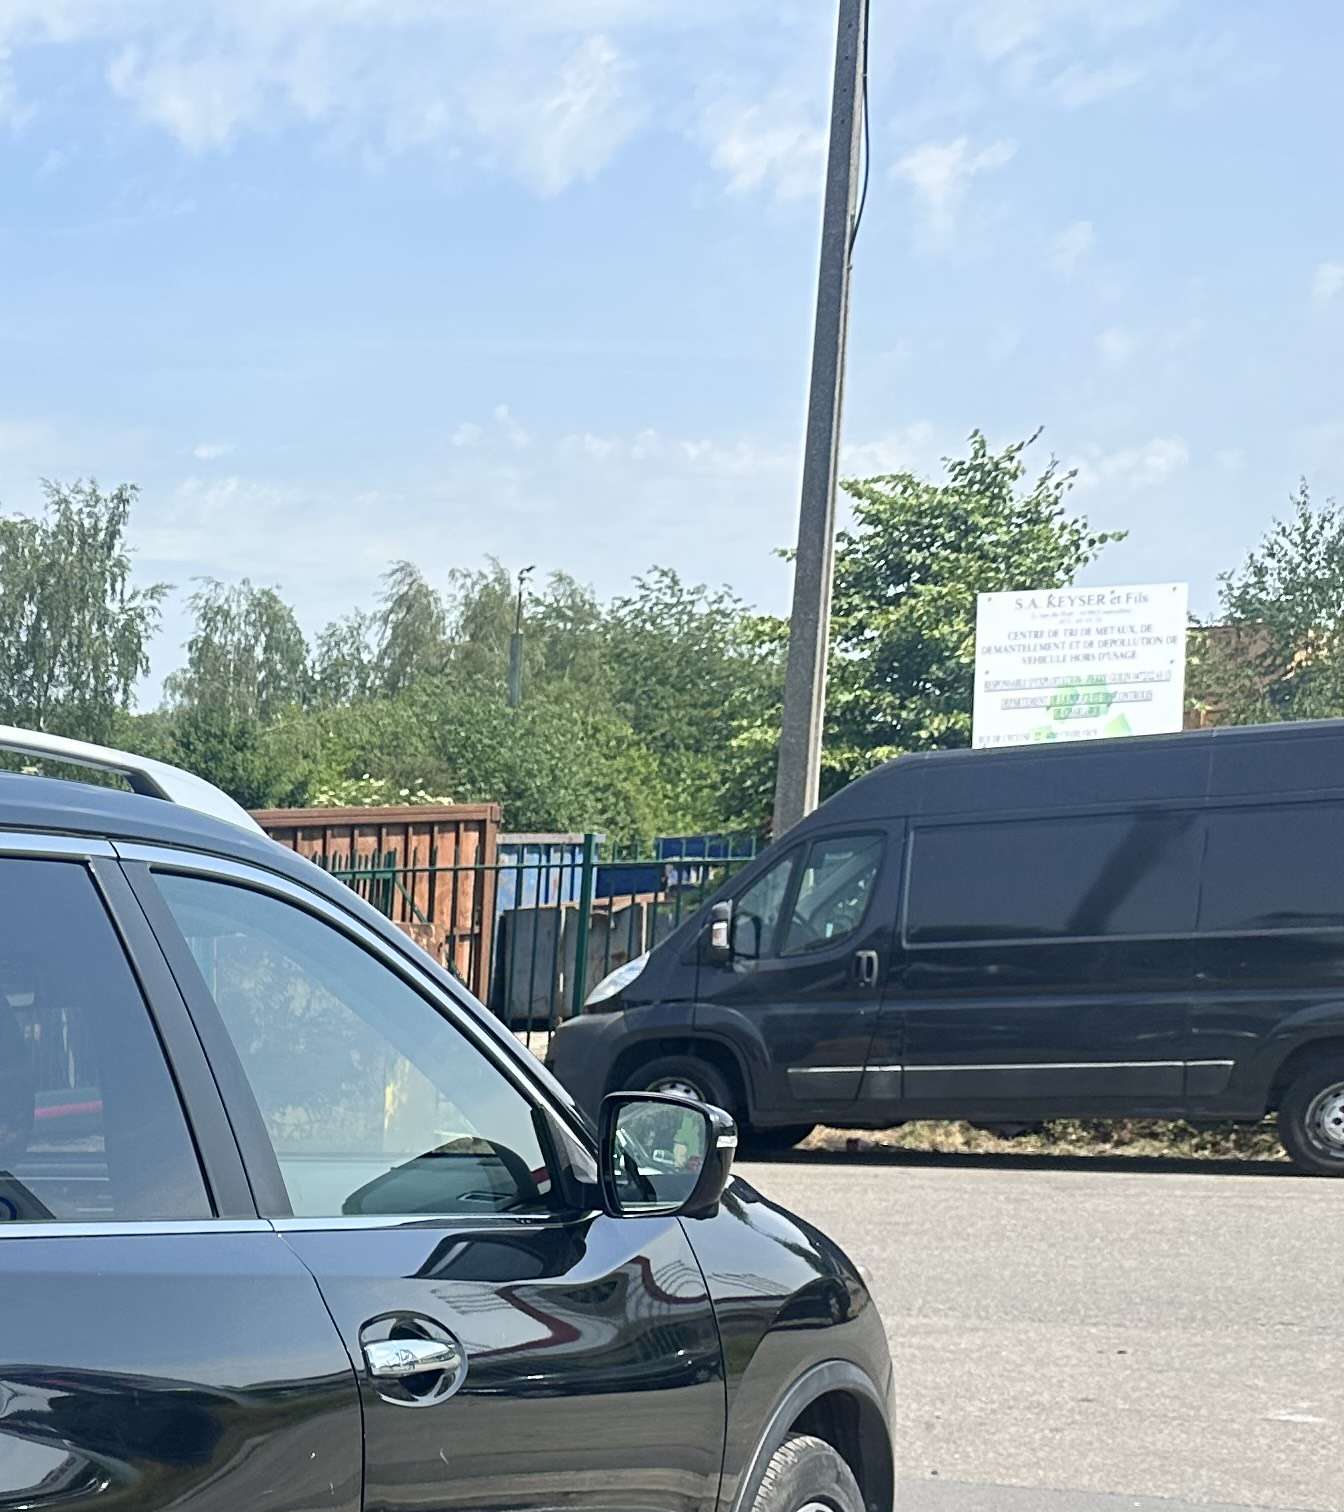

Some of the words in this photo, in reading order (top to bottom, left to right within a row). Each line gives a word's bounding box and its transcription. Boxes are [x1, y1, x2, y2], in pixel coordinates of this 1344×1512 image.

[1046, 594, 1105, 609] KEYSER
[1110, 595, 1121, 605] et
[1126, 591, 1149, 605] Fils
[1007, 629, 1044, 641] CENTRE
[1047, 628, 1059, 638] DE
[1140, 623, 1153, 634] DE
[1166, 634, 1178, 646] DE
